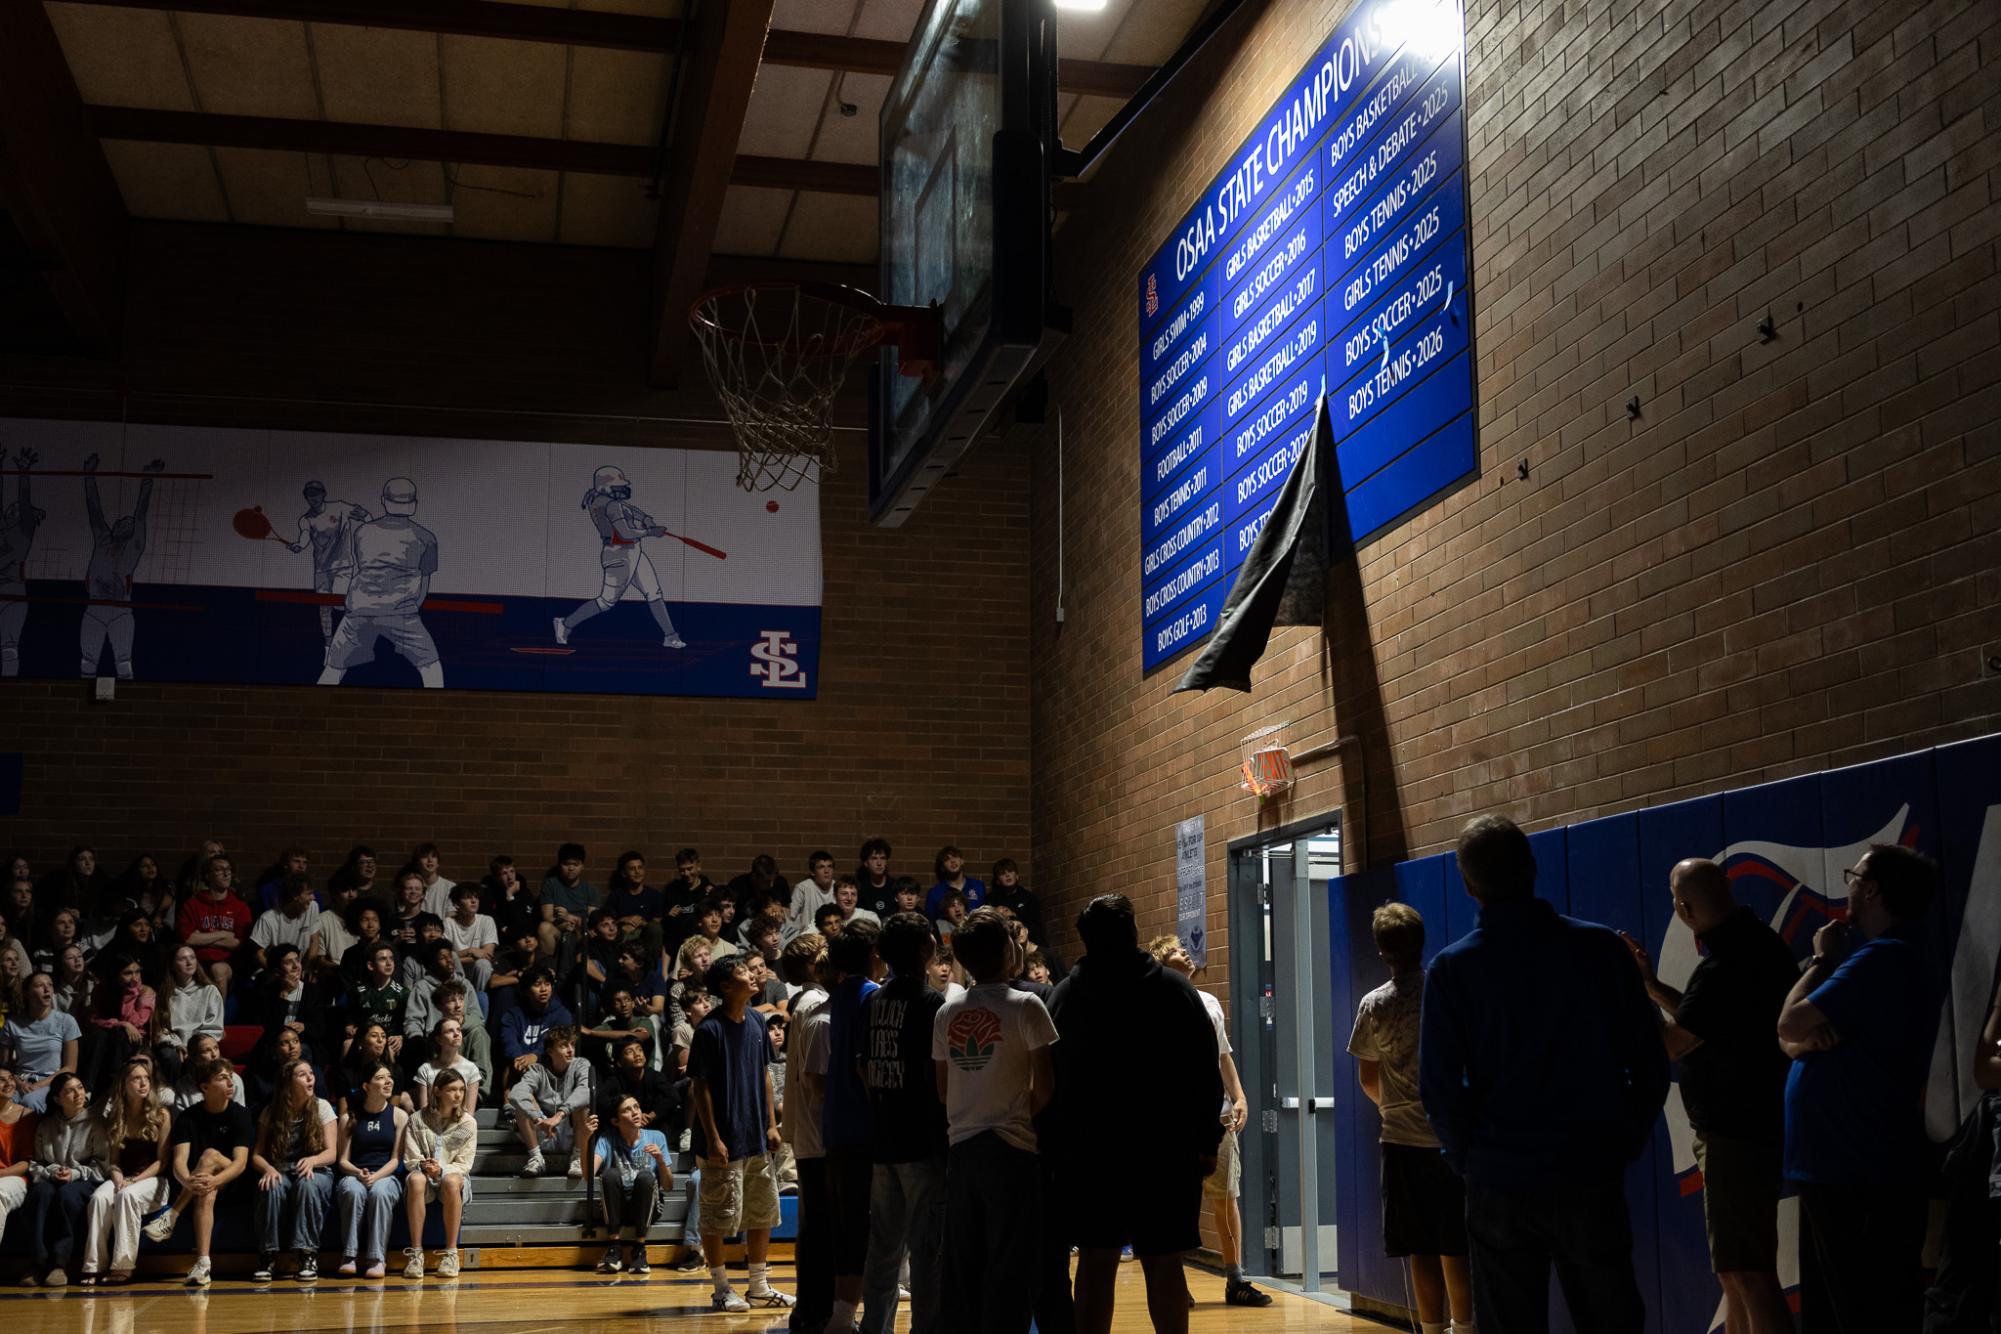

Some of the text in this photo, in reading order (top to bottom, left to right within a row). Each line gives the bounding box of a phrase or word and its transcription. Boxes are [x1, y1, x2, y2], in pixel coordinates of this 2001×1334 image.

[1331, 123, 1355, 167] BOYS
[1333, 163, 1367, 218] SPEECH
[1177, 205, 1216, 281] OSAA
[1218, 143, 1264, 235] STATE
[1345, 216, 1369, 259] BOYS
[1226, 244, 1246, 281] GIRLS
[1234, 282, 1254, 319] GIRLS
[1344, 268, 1371, 311] GIRLS
[1227, 336, 1247, 372] GIRLS
[1346, 325, 1370, 366] BOYS
[1228, 383, 1248, 417] GIRLS
[1349, 380, 1374, 420] BOYS
[1237, 424, 1256, 458] BOYS
[1238, 471, 1257, 504] BOYS
[1239, 519, 1258, 552] BOYS
